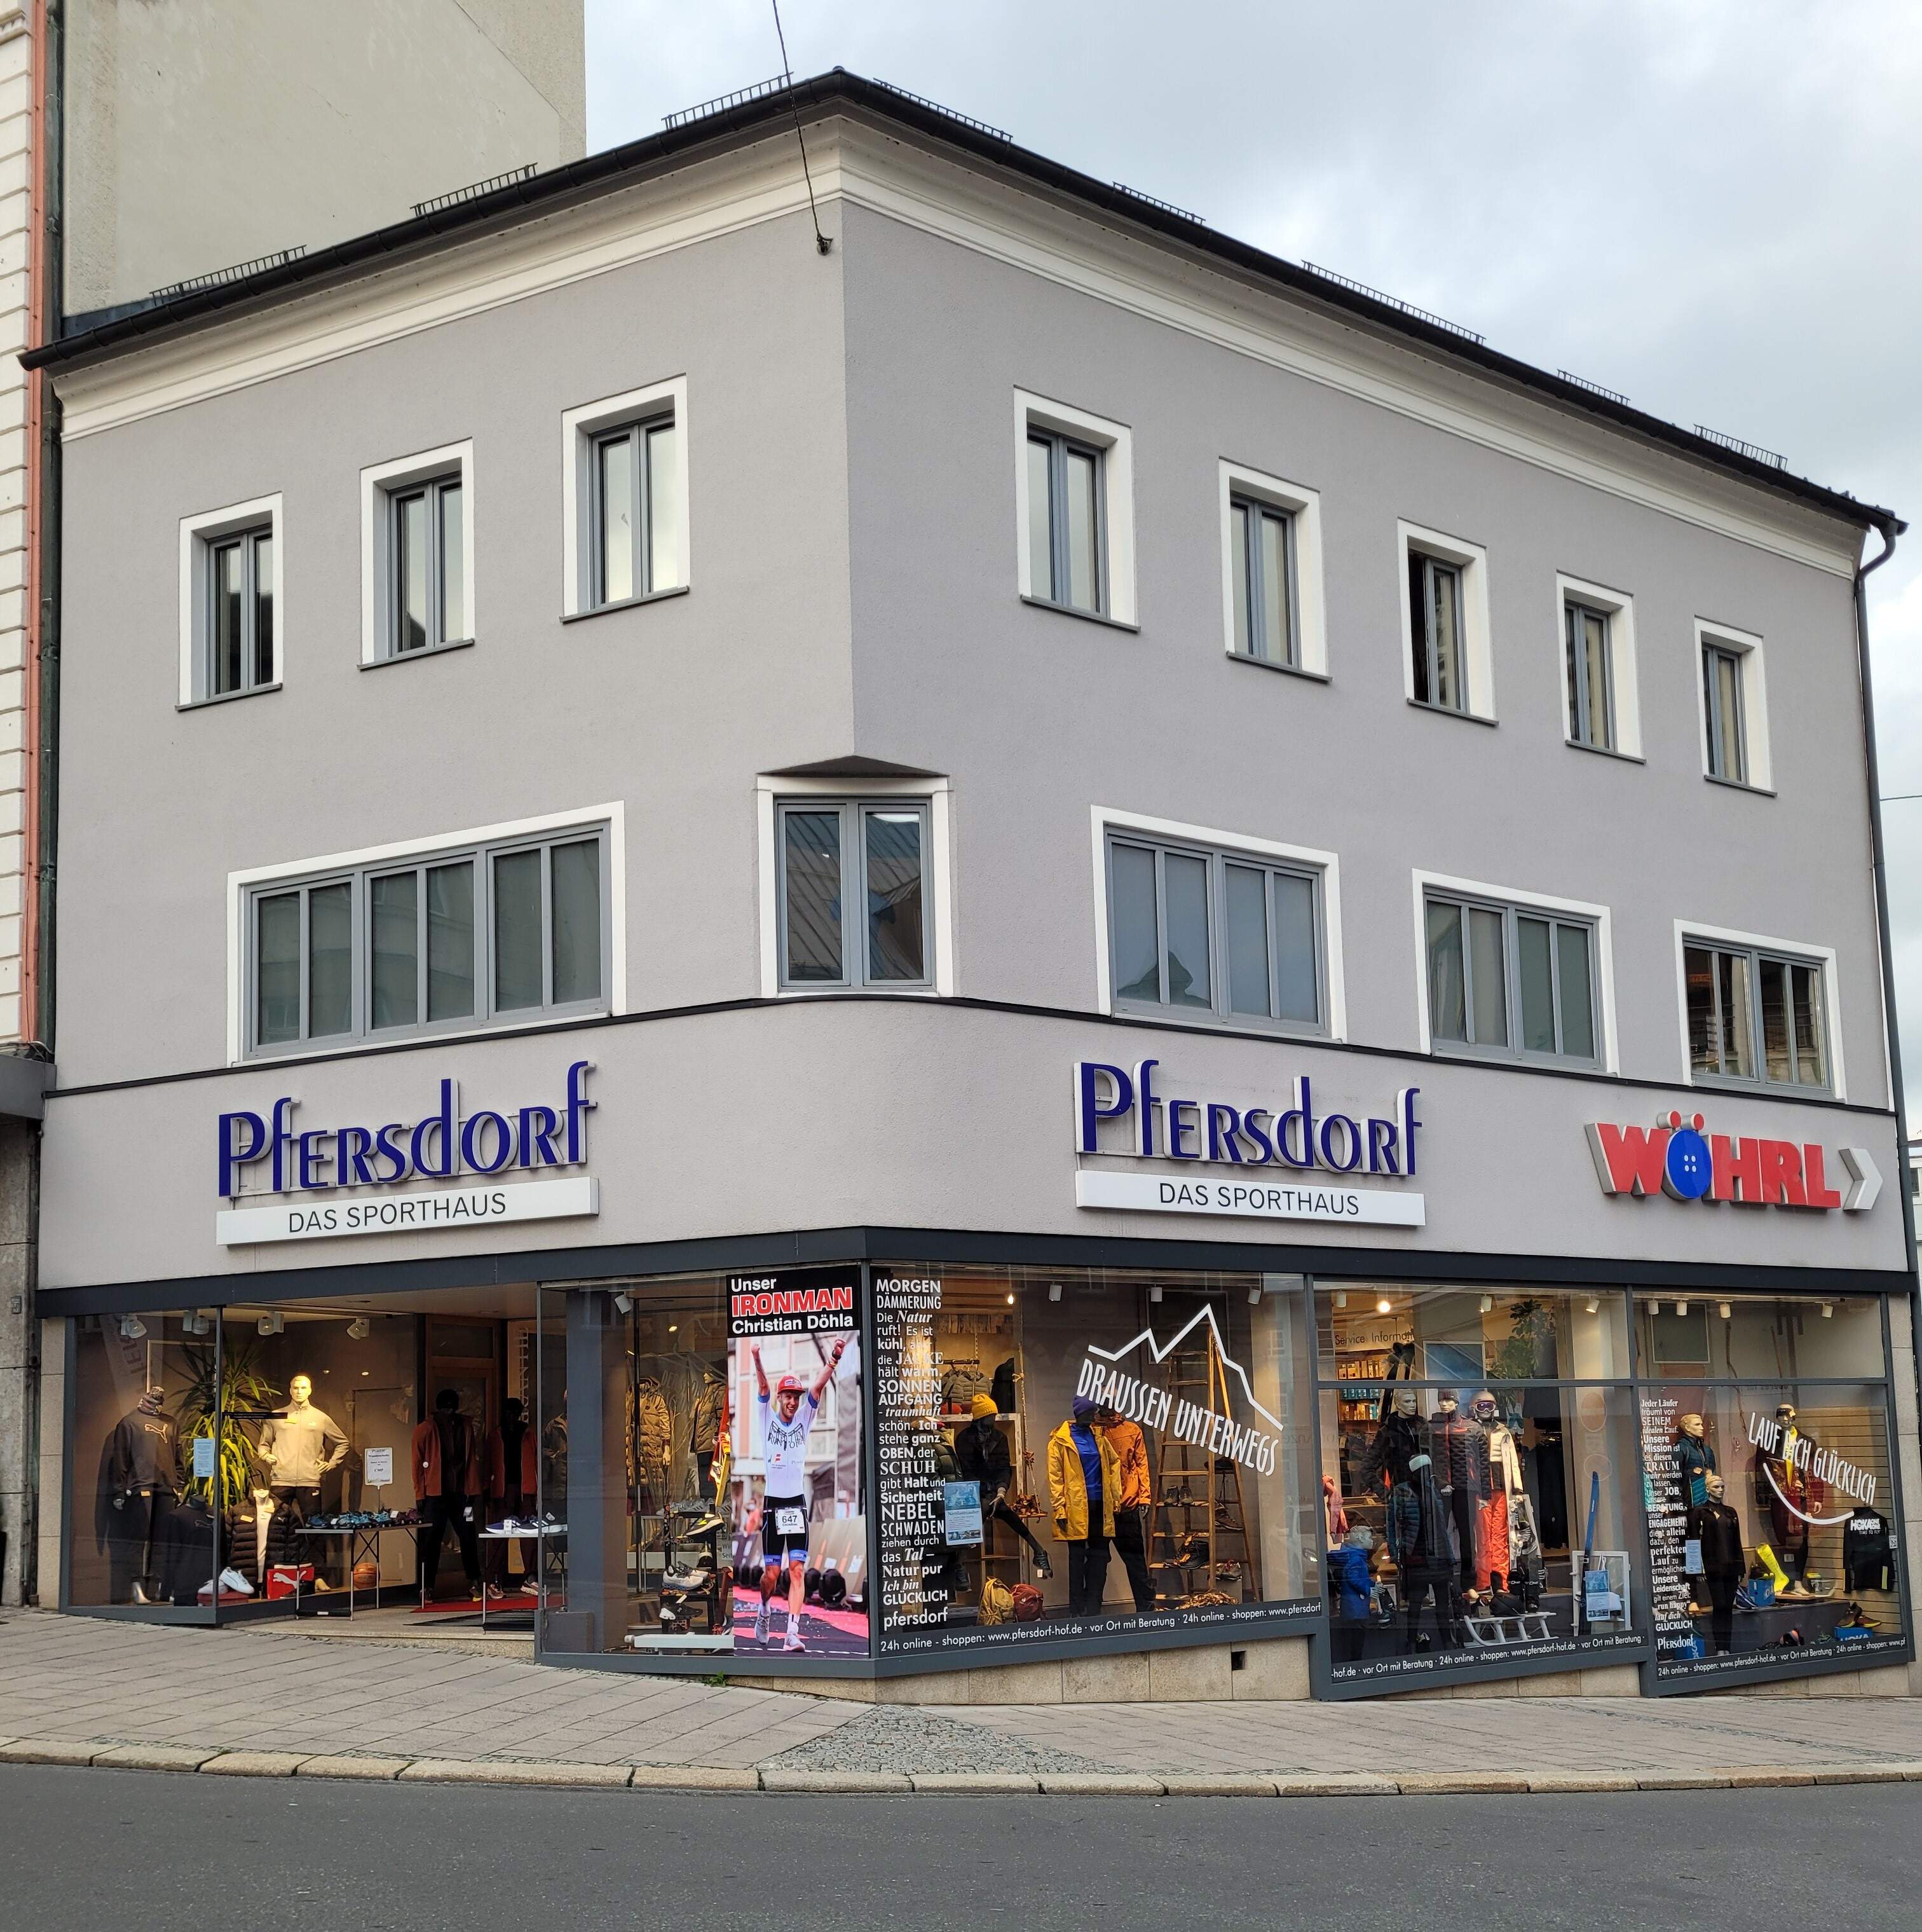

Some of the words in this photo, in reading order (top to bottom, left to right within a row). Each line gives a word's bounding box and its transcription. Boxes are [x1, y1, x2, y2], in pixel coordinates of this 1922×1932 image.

[1586, 1111, 1841, 1209] WÖHRL
[1160, 1183, 1208, 1206] DAS
[1218, 1187, 1359, 1215] SPORTHAUS
[290, 1209, 336, 1233] DAS
[347, 1193, 506, 1228] SPORTHAUS
[731, 1278, 776, 1292] Unser
[876, 1279, 941, 1292] MORGEN
[732, 1287, 853, 1317] IRONMAN
[877, 1292, 941, 1309] DÄMMERUNG
[877, 1312, 893, 1322] Die
[896, 1310, 932, 1323] Natur
[732, 1318, 801, 1334] Christian
[807, 1313, 853, 1329] Döhla
[877, 1324, 901, 1335] ruft!
[907, 1326, 917, 1335] Es
[922, 1326, 933, 1335] ist
[878, 1338, 906, 1352] kühl,
[1335, 1335, 1365, 1345] Service
[878, 1355, 892, 1364] die
[878, 1366, 899, 1377] hält
[878, 1380, 942, 1393] SONNEN
[878, 1394, 943, 1406] AUFGANG
[1658, 1399, 1678, 1407] Läufer
[885, 1406, 941, 1418] traumhaft
[1076, 1358, 1172, 1432] DRAUSSEN
[1174, 1399, 1279, 1476] UNTERWEGS
[1641, 1408, 1662, 1416] träumt
[879, 1420, 914, 1431] schön.
[918, 1420, 937, 1430] Ich
[1642, 1416, 1671, 1425] SEINEM
[879, 1433, 909, 1444] stehe
[911, 1435, 940, 1446] ganz
[1643, 1435, 1670, 1443] Unsere
[880, 1447, 916, 1460] OBEN,
[917, 1447, 935, 1458] der
[1644, 1444, 1672, 1452] Mission
[1748, 1412, 1782, 1455] LAUF
[1813, 1447, 1876, 1506] GLÜCKLICH
[880, 1460, 936, 1475] SCHUH
[1644, 1461, 1680, 1471] TRAUM
[880, 1478, 901, 1491] gibt
[904, 1476, 929, 1488] Halt
[930, 1478, 945, 1487] und
[880, 1490, 945, 1504] Sicherheit.
[1665, 1486, 1681, 1496] JOB,
[882, 1502, 936, 1521] NEBEL
[782, 1515, 797, 1523] 647
[881, 1520, 944, 1537] SCHWADEN
[1666, 1527, 1686, 1536] allein
[882, 1537, 911, 1548] ziehen
[914, 1535, 939, 1545] durch
[882, 1552, 901, 1563] das
[904, 1547, 924, 1561] Tal
[1650, 1544, 1687, 1556] perfekten
[1651, 1555, 1670, 1566] Lauf
[882, 1564, 920, 1578] Natur
[922, 1565, 943, 1578] pur
[882, 1580, 899, 1592] Ich
[903, 1579, 919, 1590] bin
[1653, 1575, 1678, 1584] Unsere
[1653, 1582, 1690, 1593] Leidenschaft
[883, 1589, 948, 1605] GLÜCKLICH
[883, 1607, 948, 1631] pfersdorf
[1668, 1611, 1681, 1620] dich
[881, 1639, 899, 1652] 24h
[903, 1637, 932, 1650] online
[942, 1634, 985, 1647] shoppen:
[988, 1622, 1082, 1642] www.pfersdorf-hof.de
[1089, 1623, 1103, 1632] vor
[1106, 1620, 1121, 1632] Ort
[1123, 1619, 1136, 1629] mit
[1139, 1616, 1175, 1628] Beratung
[1183, 1613, 1199, 1624] 24h
[1201, 1610, 1224, 1622] online
[1232, 1608, 1267, 1620] shoppen:
[1268, 1602, 1321, 1617] www.pfersdorf
[1331, 1666, 1356, 1678] -hof.de
[1362, 1667, 1374, 1675] vor
[1376, 1663, 1388, 1673] Ort
[1389, 1661, 1401, 1671] mit
[1403, 1659, 1433, 1670] Beratung
[1440, 1656, 1453, 1666] 24h
[1454, 1653, 1475, 1664] online
[1480, 1650, 1510, 1662] shoppen:
[1511, 1641, 1576, 1657] www.pfersdorf-hof.de
[1581, 1640, 1591, 1648] vor
[1592, 1638, 1603, 1647] Ort
[1604, 1636, 1614, 1646] mit
[1615, 1634, 1641, 1645] Beratung
[1658, 1666, 1670, 1676] 24h
[1671, 1665, 1689, 1675] online
[1693, 1662, 1719, 1673] shoppen:
[1720, 1655, 1776, 1668] www.pfersdorf-hof.de
[1790, 1651, 1800, 1659] Ort
[1800, 1650, 1809, 1658] mit
[1810, 1648, 1832, 1657] Beratung
[1836, 1645, 1846, 1654] 24h
[1847, 1643, 1862, 1652] online
[1866, 1641, 1888, 1650] shoppen:
[1888, 1637, 1905, 1647] www.pf
